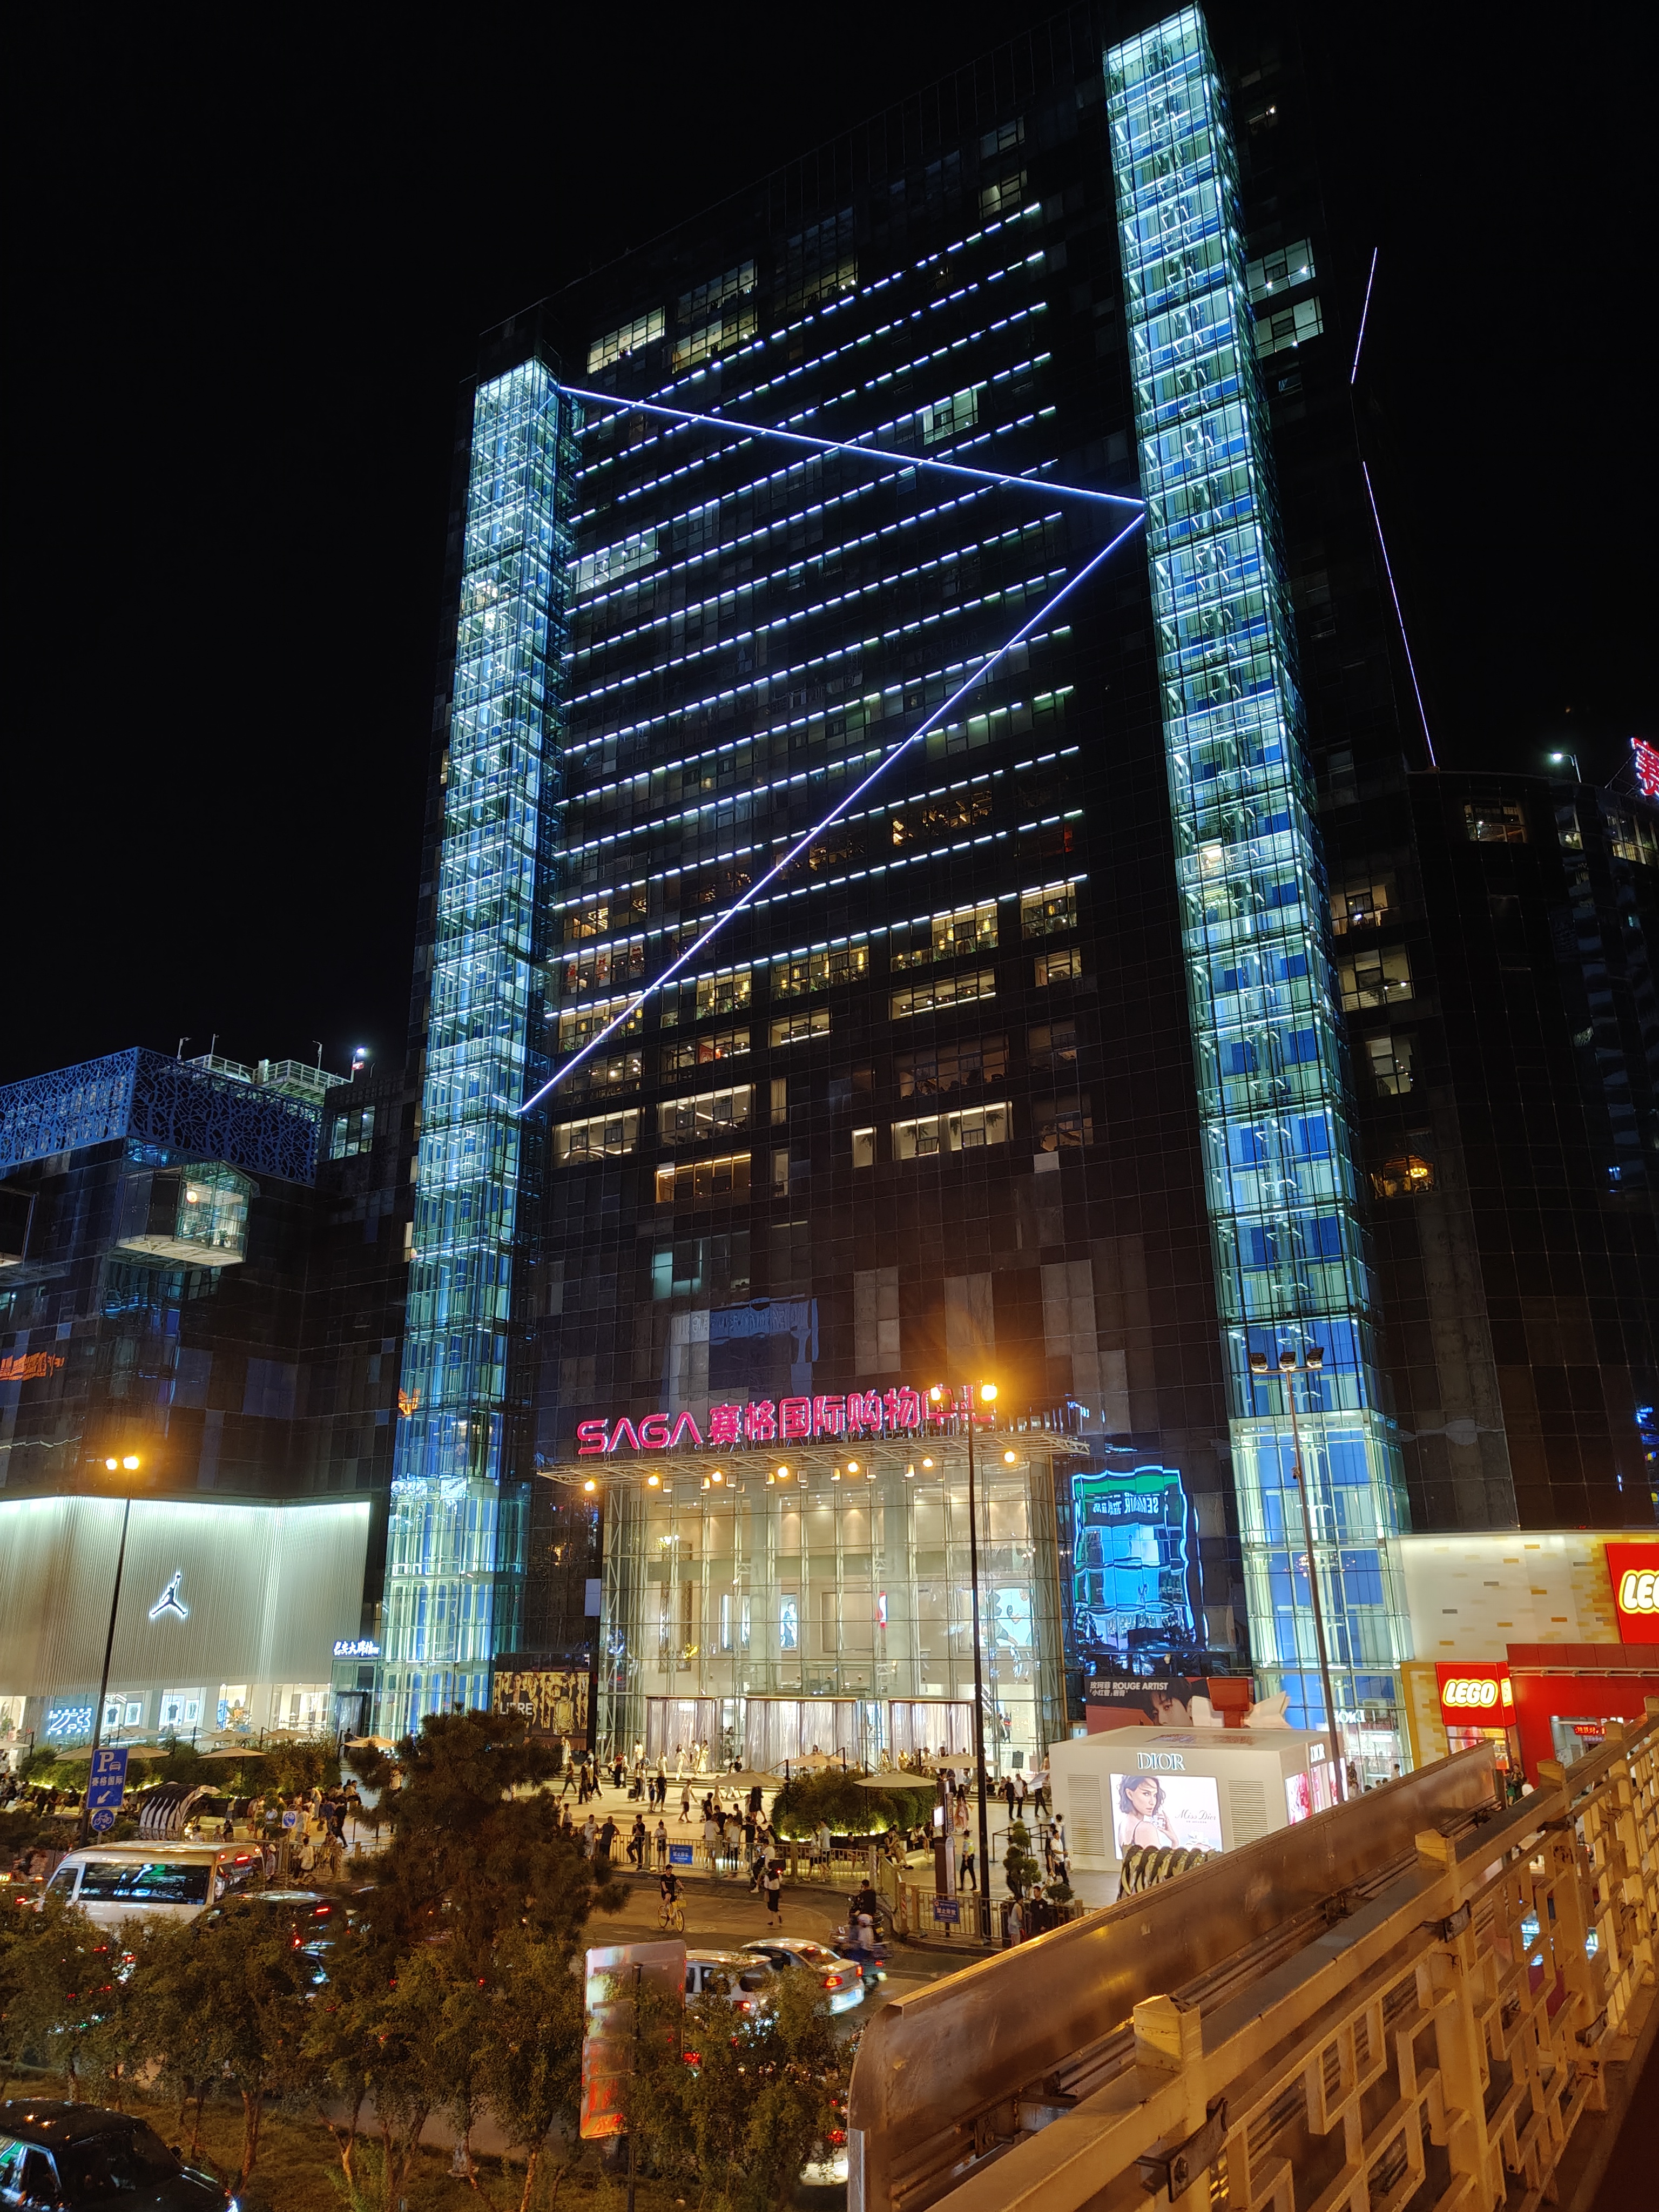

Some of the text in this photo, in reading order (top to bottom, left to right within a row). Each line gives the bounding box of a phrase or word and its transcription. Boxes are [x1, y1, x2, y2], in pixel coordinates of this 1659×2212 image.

[577, 1411, 704, 1455] SAGA
[1112, 1682, 1141, 1690] ROUGE
[1142, 1682, 1169, 1691] ARTIST
[1445, 1681, 1496, 1705] LEGO
[97, 1751, 114, 1772] P
[1137, 1752, 1186, 1771] DIOR
[1310, 1743, 1326, 1763] DIOR
[92, 1776, 123, 1786] 赛格国际
[1175, 1809, 1216, 1820] Miss Dior
